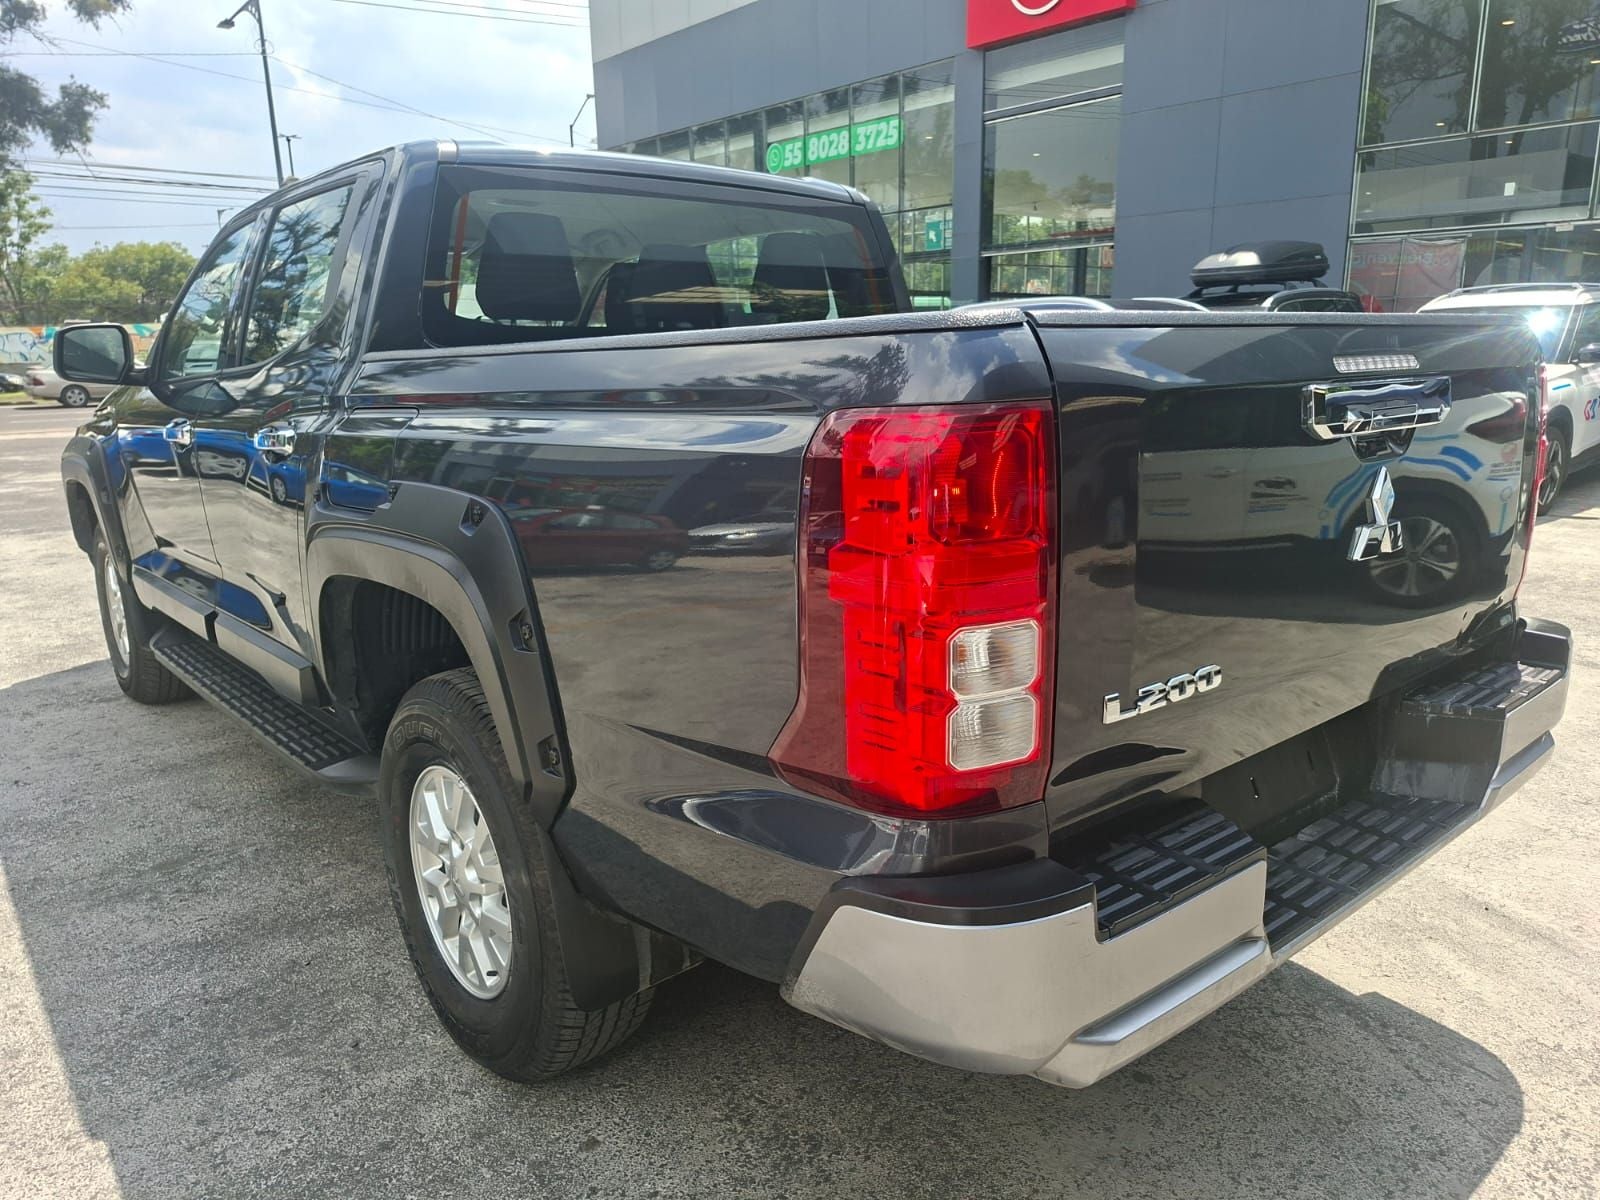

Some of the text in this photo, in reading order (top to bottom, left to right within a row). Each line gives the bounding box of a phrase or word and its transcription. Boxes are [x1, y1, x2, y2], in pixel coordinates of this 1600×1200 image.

[784, 119, 899, 167] 55 8028 3725
[1102, 664, 1223, 725] L200
